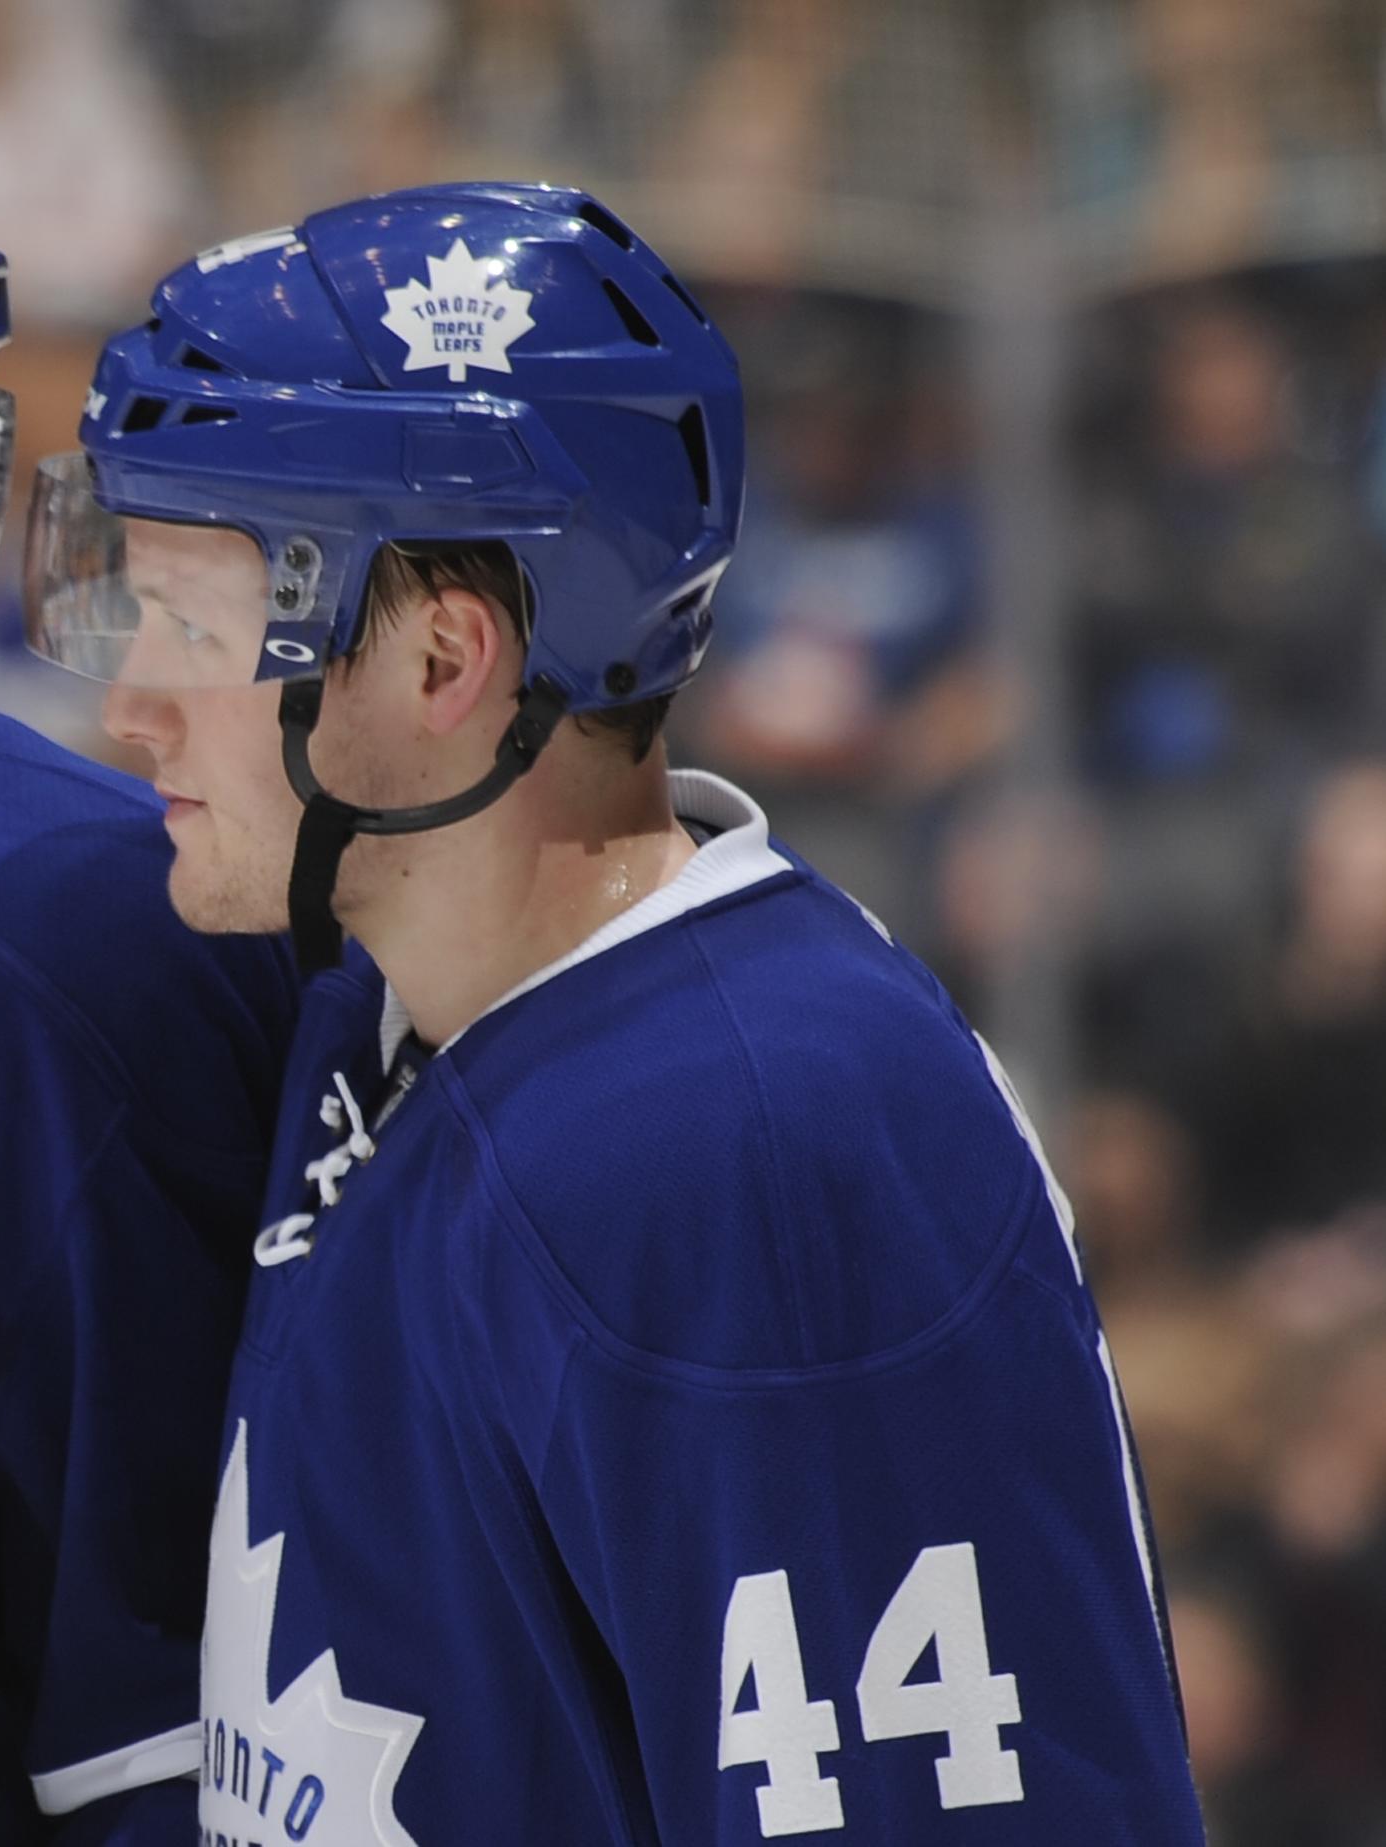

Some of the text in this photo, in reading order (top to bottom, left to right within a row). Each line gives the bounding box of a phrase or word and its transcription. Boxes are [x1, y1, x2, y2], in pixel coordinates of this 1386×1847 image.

[411, 295, 508, 322] TORONTO
[432, 321, 485, 336] MAPLE
[433, 338, 482, 353] LEAFS
[718, 1541, 1024, 1838] 44
